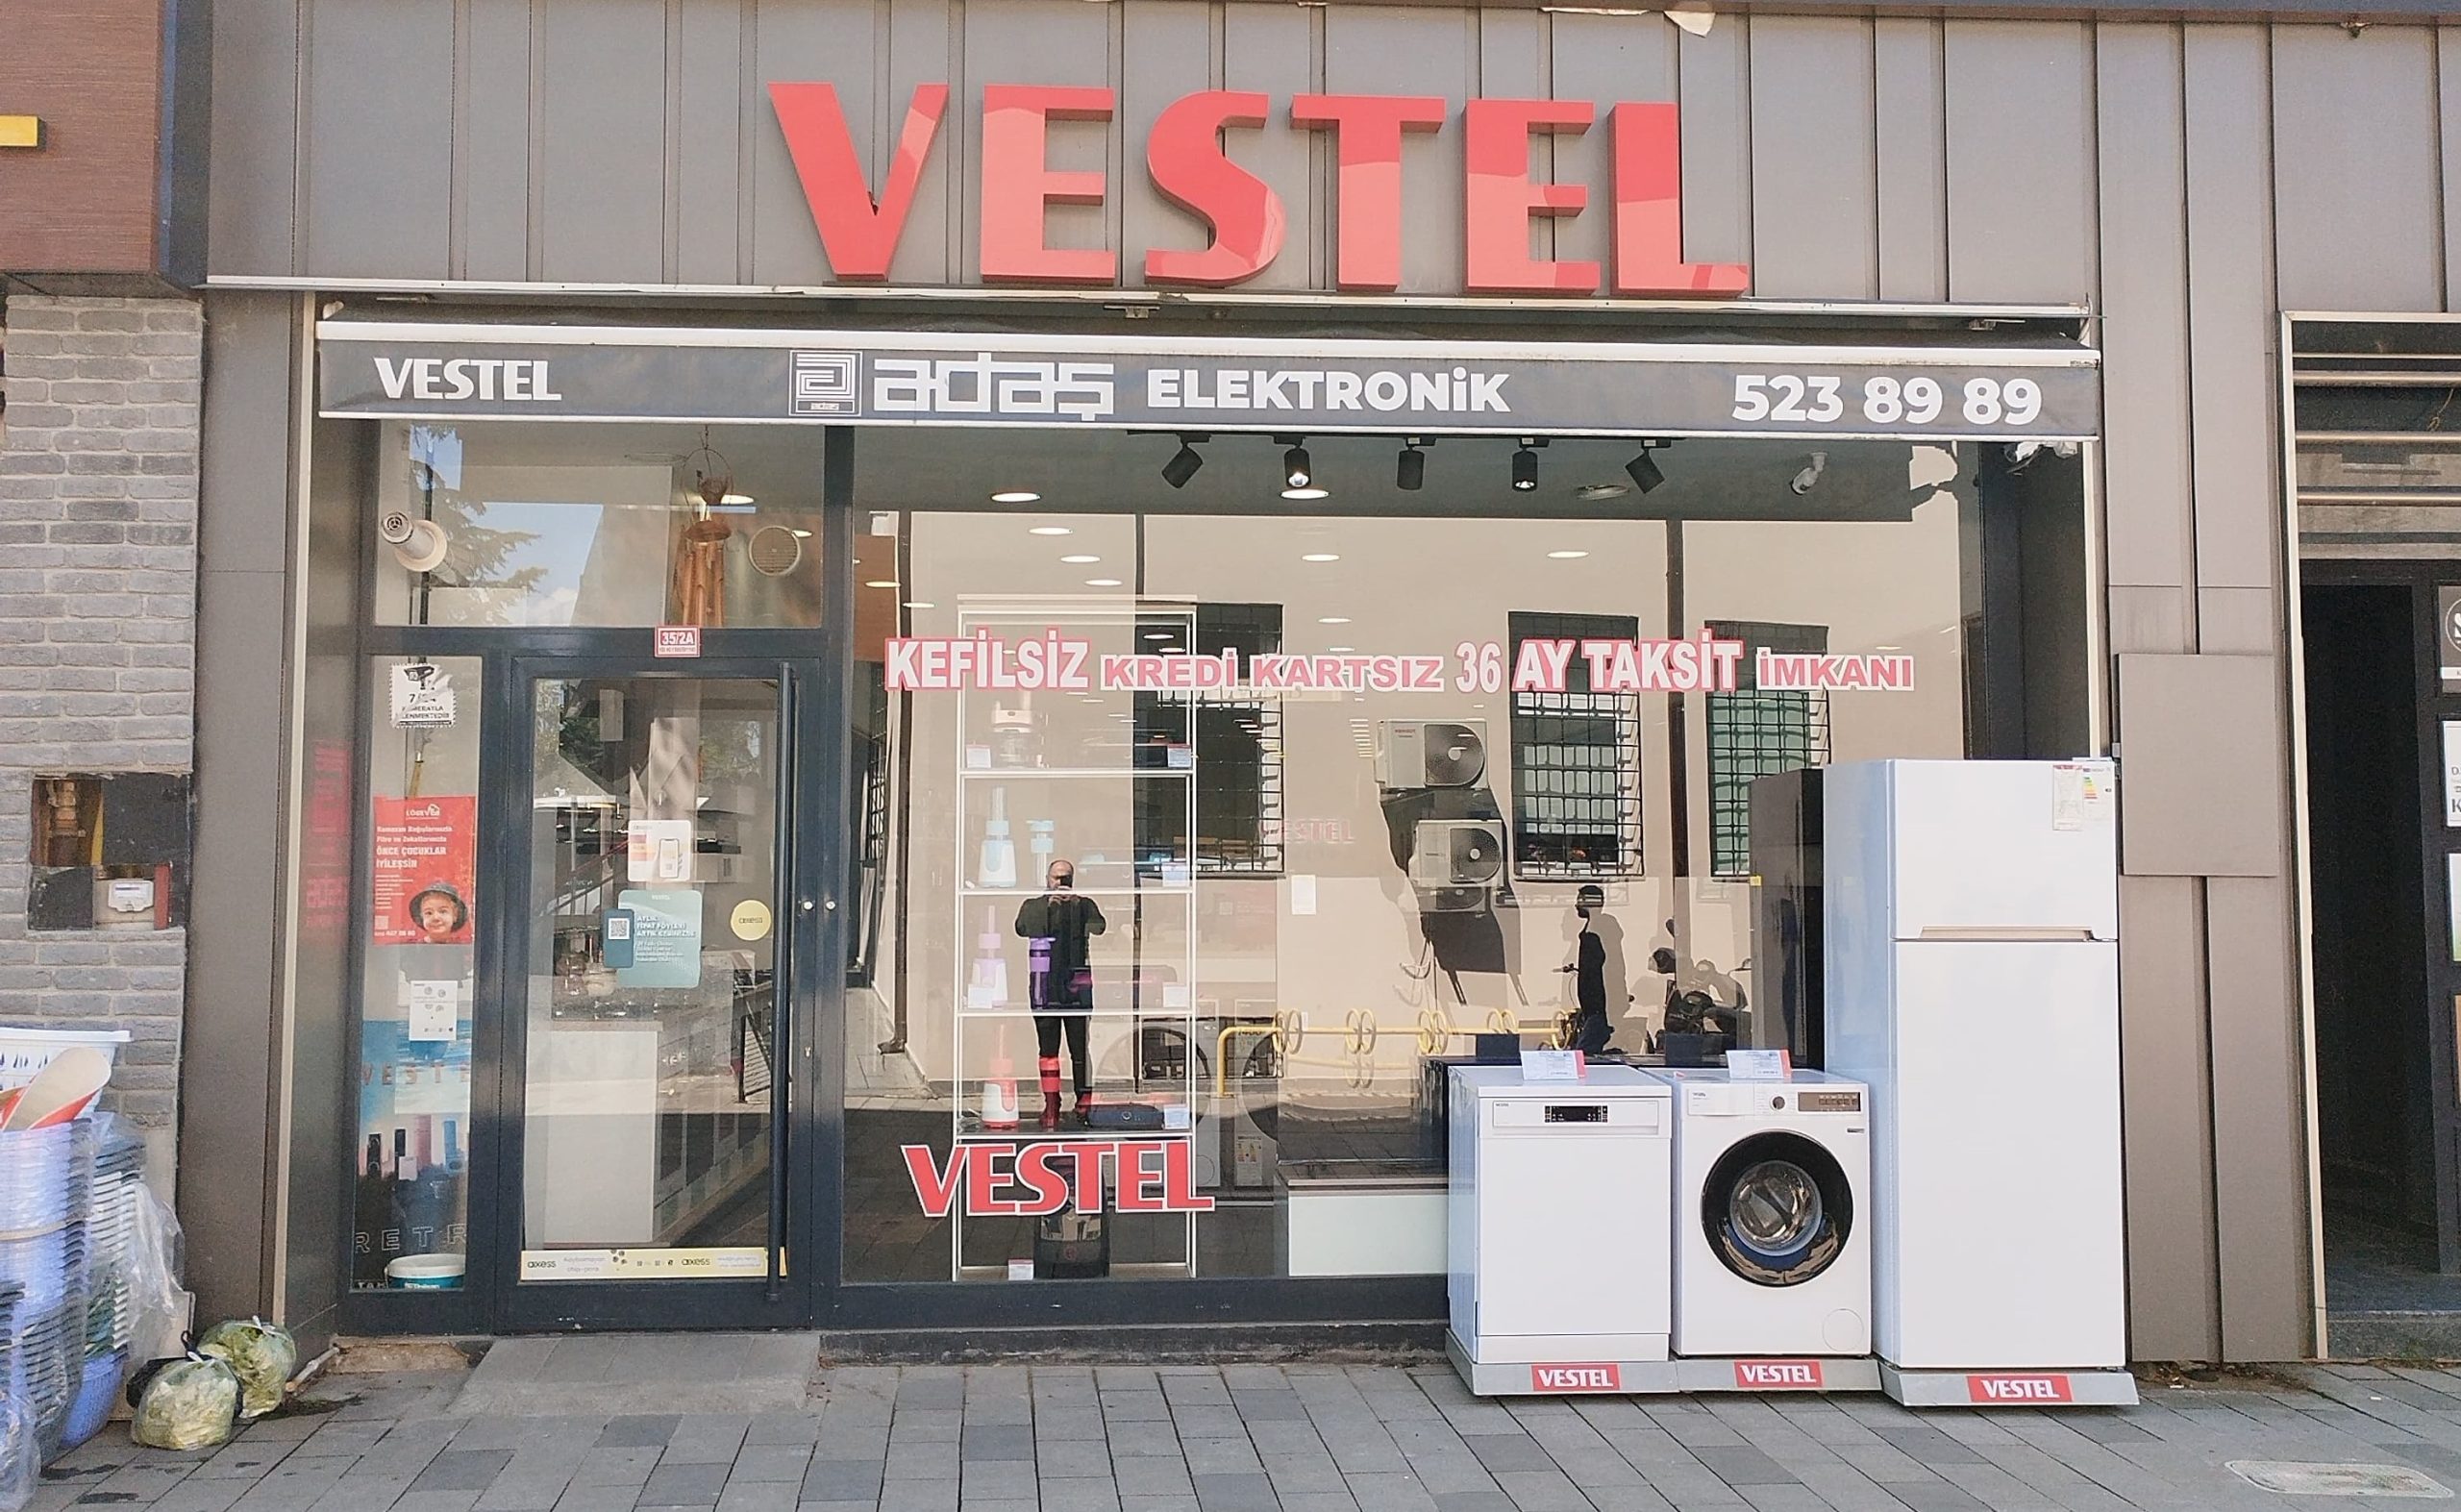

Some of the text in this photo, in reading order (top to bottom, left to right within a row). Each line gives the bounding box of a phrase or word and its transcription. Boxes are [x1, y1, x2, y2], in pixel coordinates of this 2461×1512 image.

[767, 83, 1750, 298] VESTEL
[374, 357, 562, 402] VESTEL
[1731, 374, 2042, 425] 523 89 89
[885, 627, 1915, 693] KEFİLSİZ KREDİ KARTSIZ 36 AY TAKSİT İMKANI
[901, 1140, 1215, 1218] VESTEL
[1537, 1368, 1614, 1388] VESTEL
[1740, 1365, 1817, 1383] VESTEL
[1980, 1378, 2061, 1399] VESTEL
